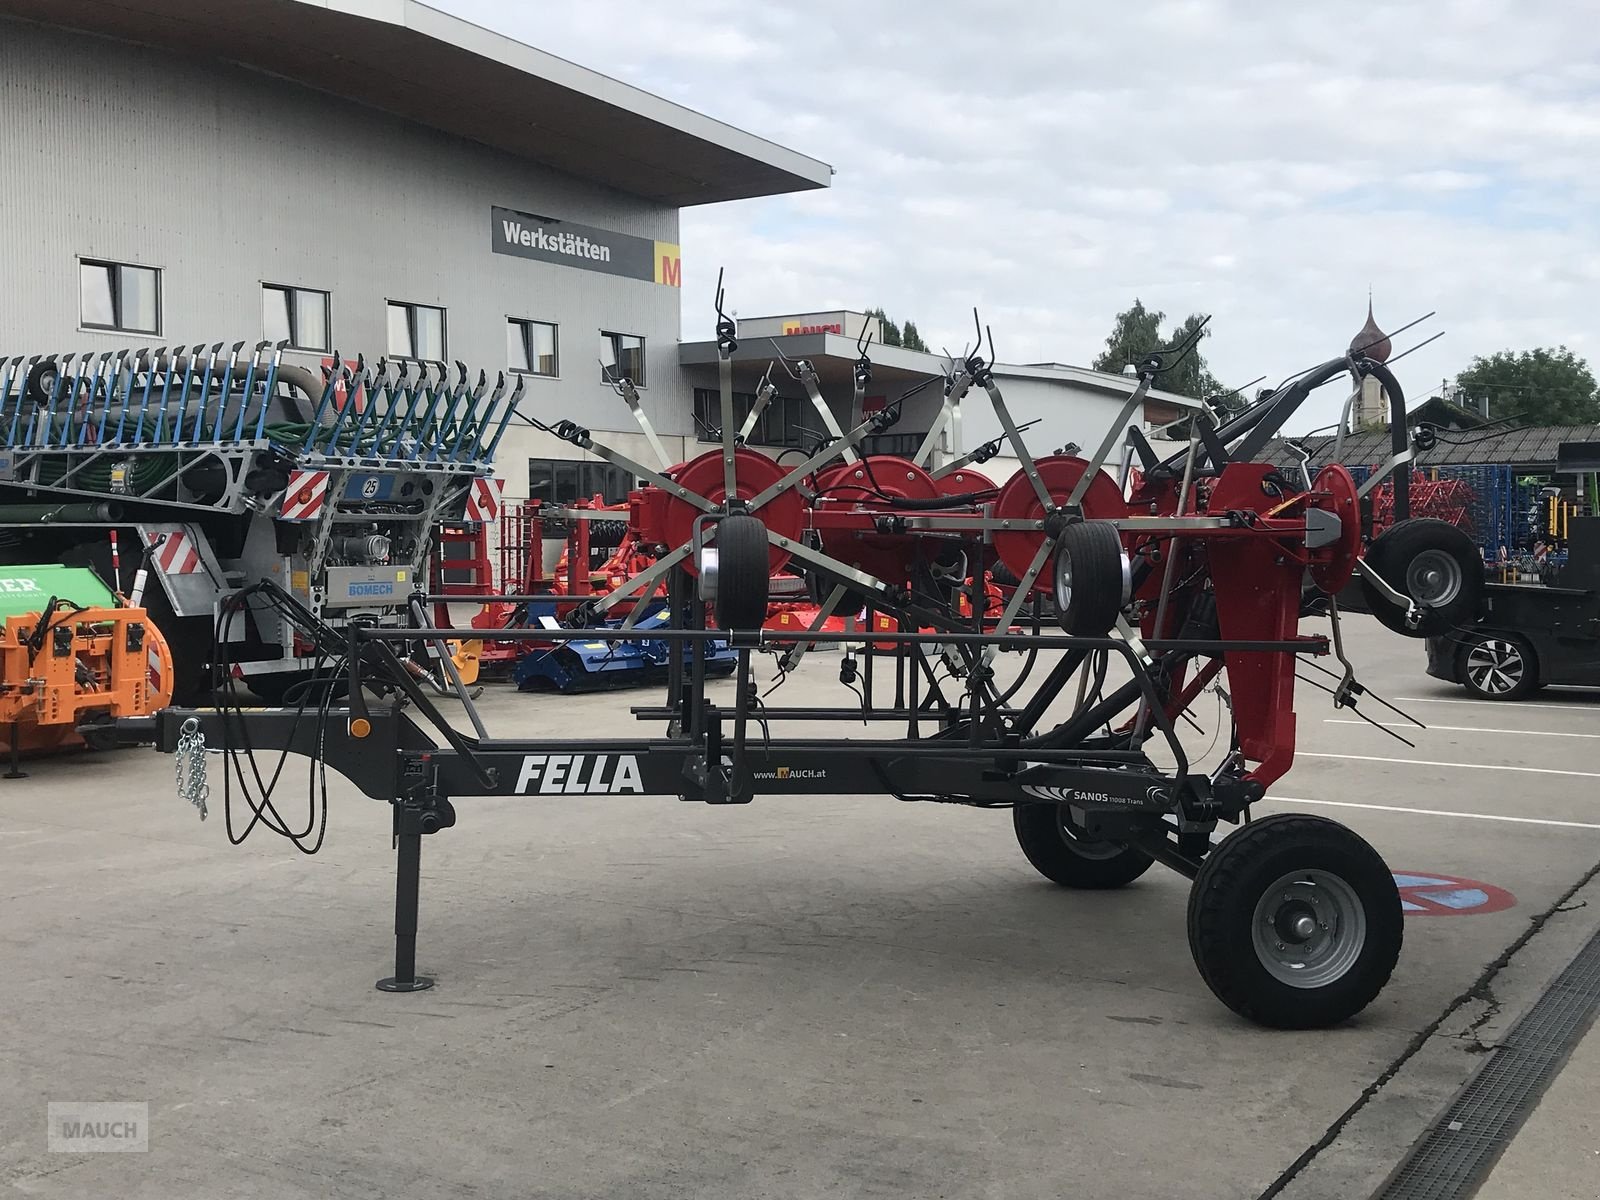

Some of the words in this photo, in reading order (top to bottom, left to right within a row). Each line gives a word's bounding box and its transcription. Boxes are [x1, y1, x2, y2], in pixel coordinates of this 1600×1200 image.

[503, 219, 610, 262] Werkstätten
[364, 480, 377, 494] 25
[0, 578, 42, 593] ER
[348, 584, 393, 596] BOMECH
[514, 754, 645, 794] FELLA
[753, 767, 827, 780] www.MAUCH.at
[1074, 791, 1108, 802] SANOS
